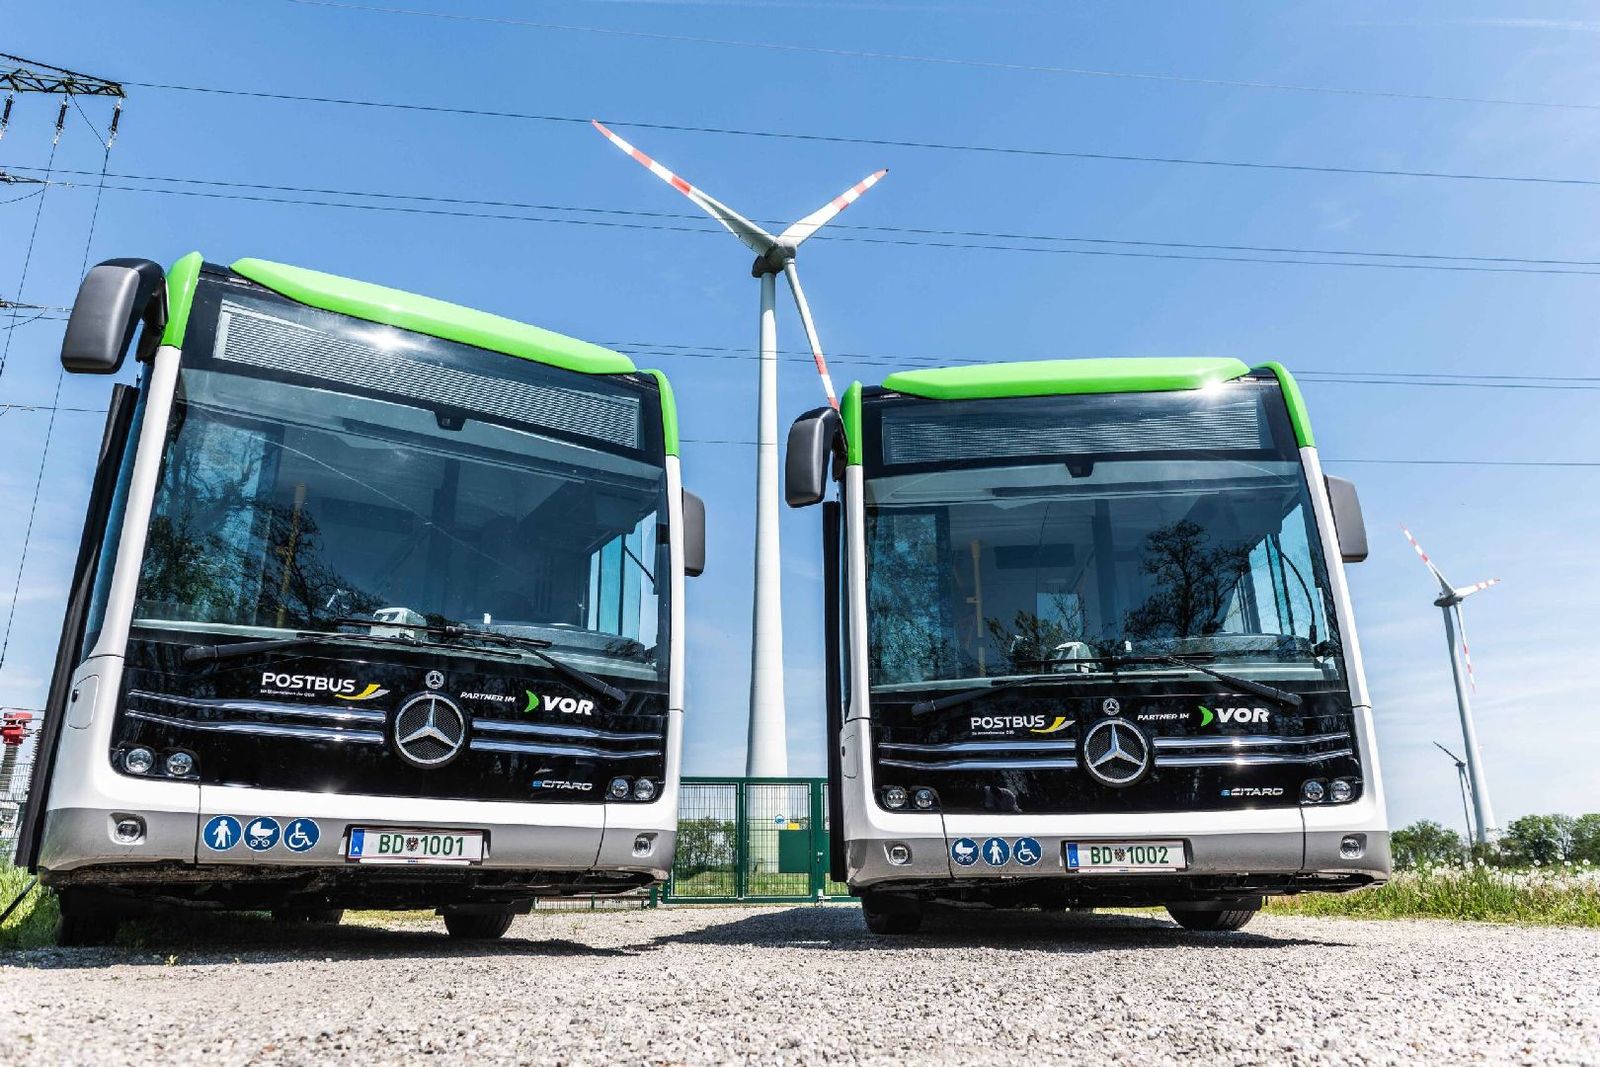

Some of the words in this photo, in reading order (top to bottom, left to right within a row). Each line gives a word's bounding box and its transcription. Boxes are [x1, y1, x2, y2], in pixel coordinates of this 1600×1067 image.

[261, 672, 356, 693] POSTBUS
[460, 691, 504, 702] PARTNER
[542, 695, 594, 716] VOR
[970, 714, 1046, 729] POSTBUS
[1137, 713, 1178, 721] PARTNER
[1179, 712, 1190, 720] IM
[1214, 707, 1270, 723] VOR
[378, 834, 405, 854] BD
[420, 835, 464, 856] 1001
[1090, 846, 1113, 865] BD
[1126, 846, 1169, 865] 1002
